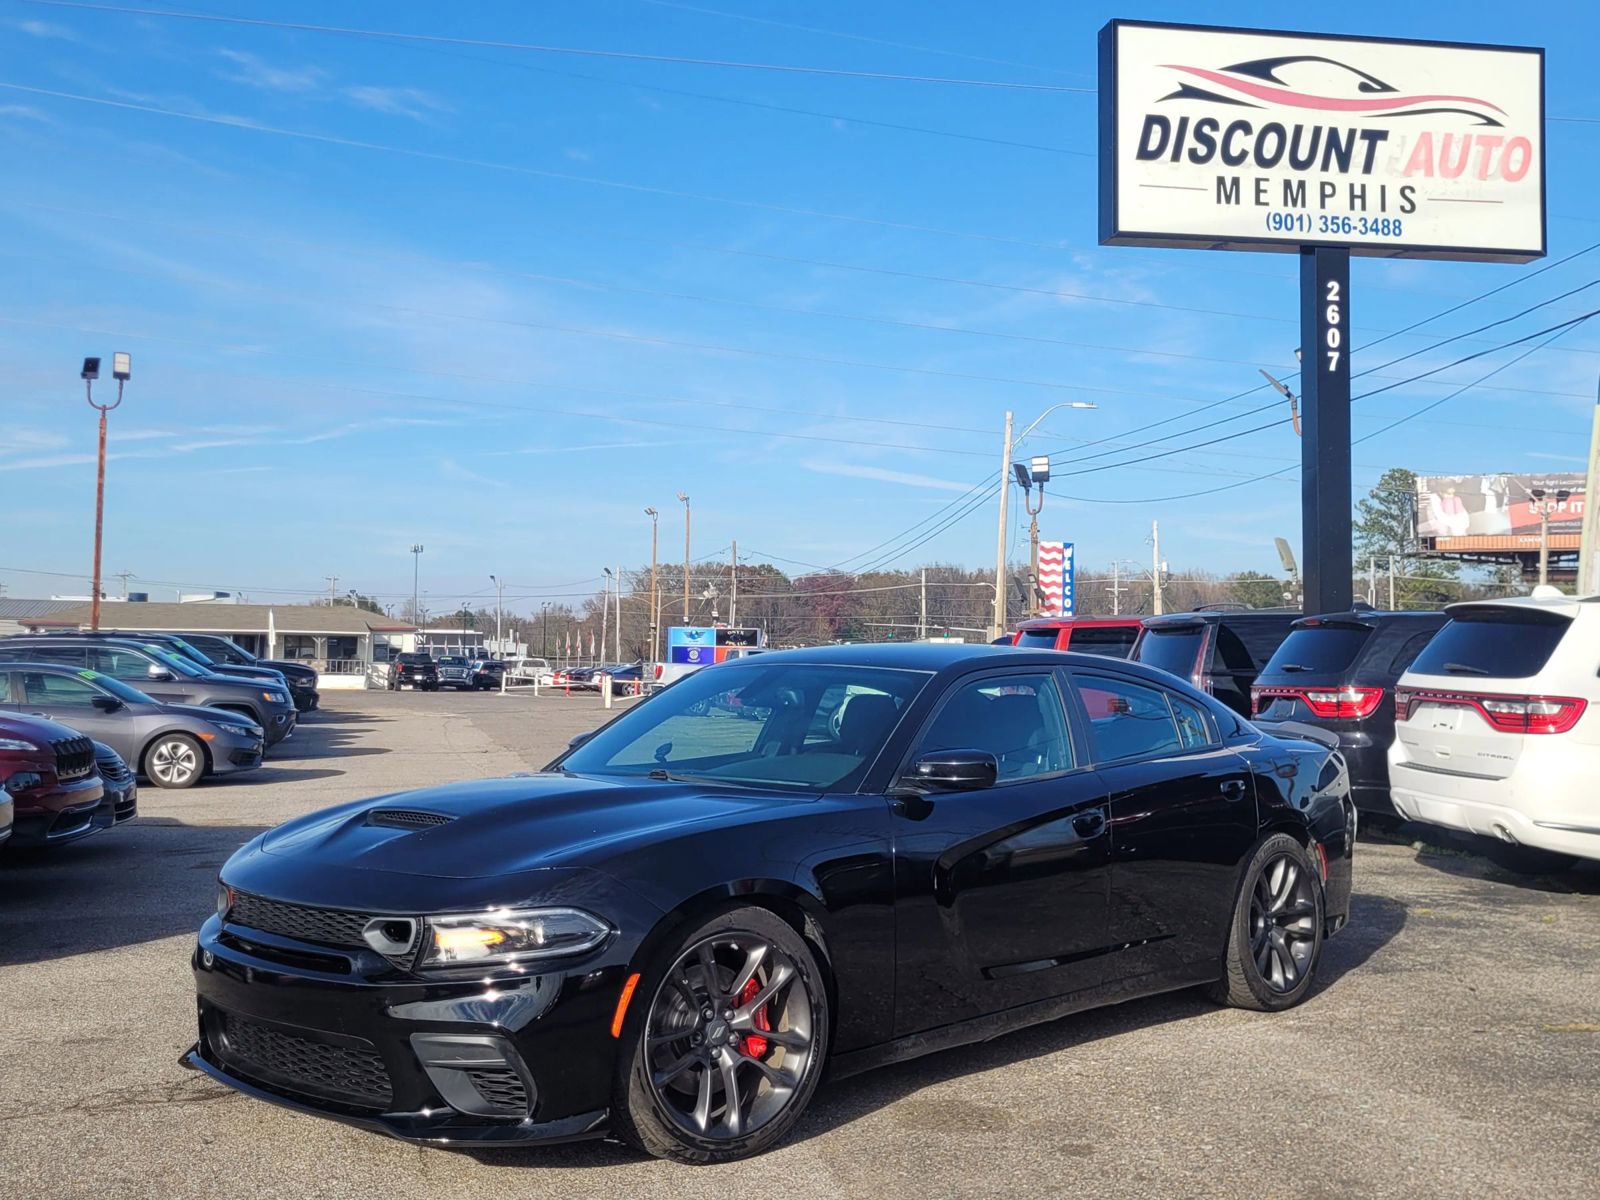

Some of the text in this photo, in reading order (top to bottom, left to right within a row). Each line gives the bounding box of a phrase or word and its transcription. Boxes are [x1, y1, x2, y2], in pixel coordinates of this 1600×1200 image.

[1135, 113, 1532, 182] DISCOUNT AUTO
[1216, 175, 1416, 214] MEMPHIS
[1266, 211, 1403, 237] (901) 356-3488
[1326, 280, 1340, 371] 2607
